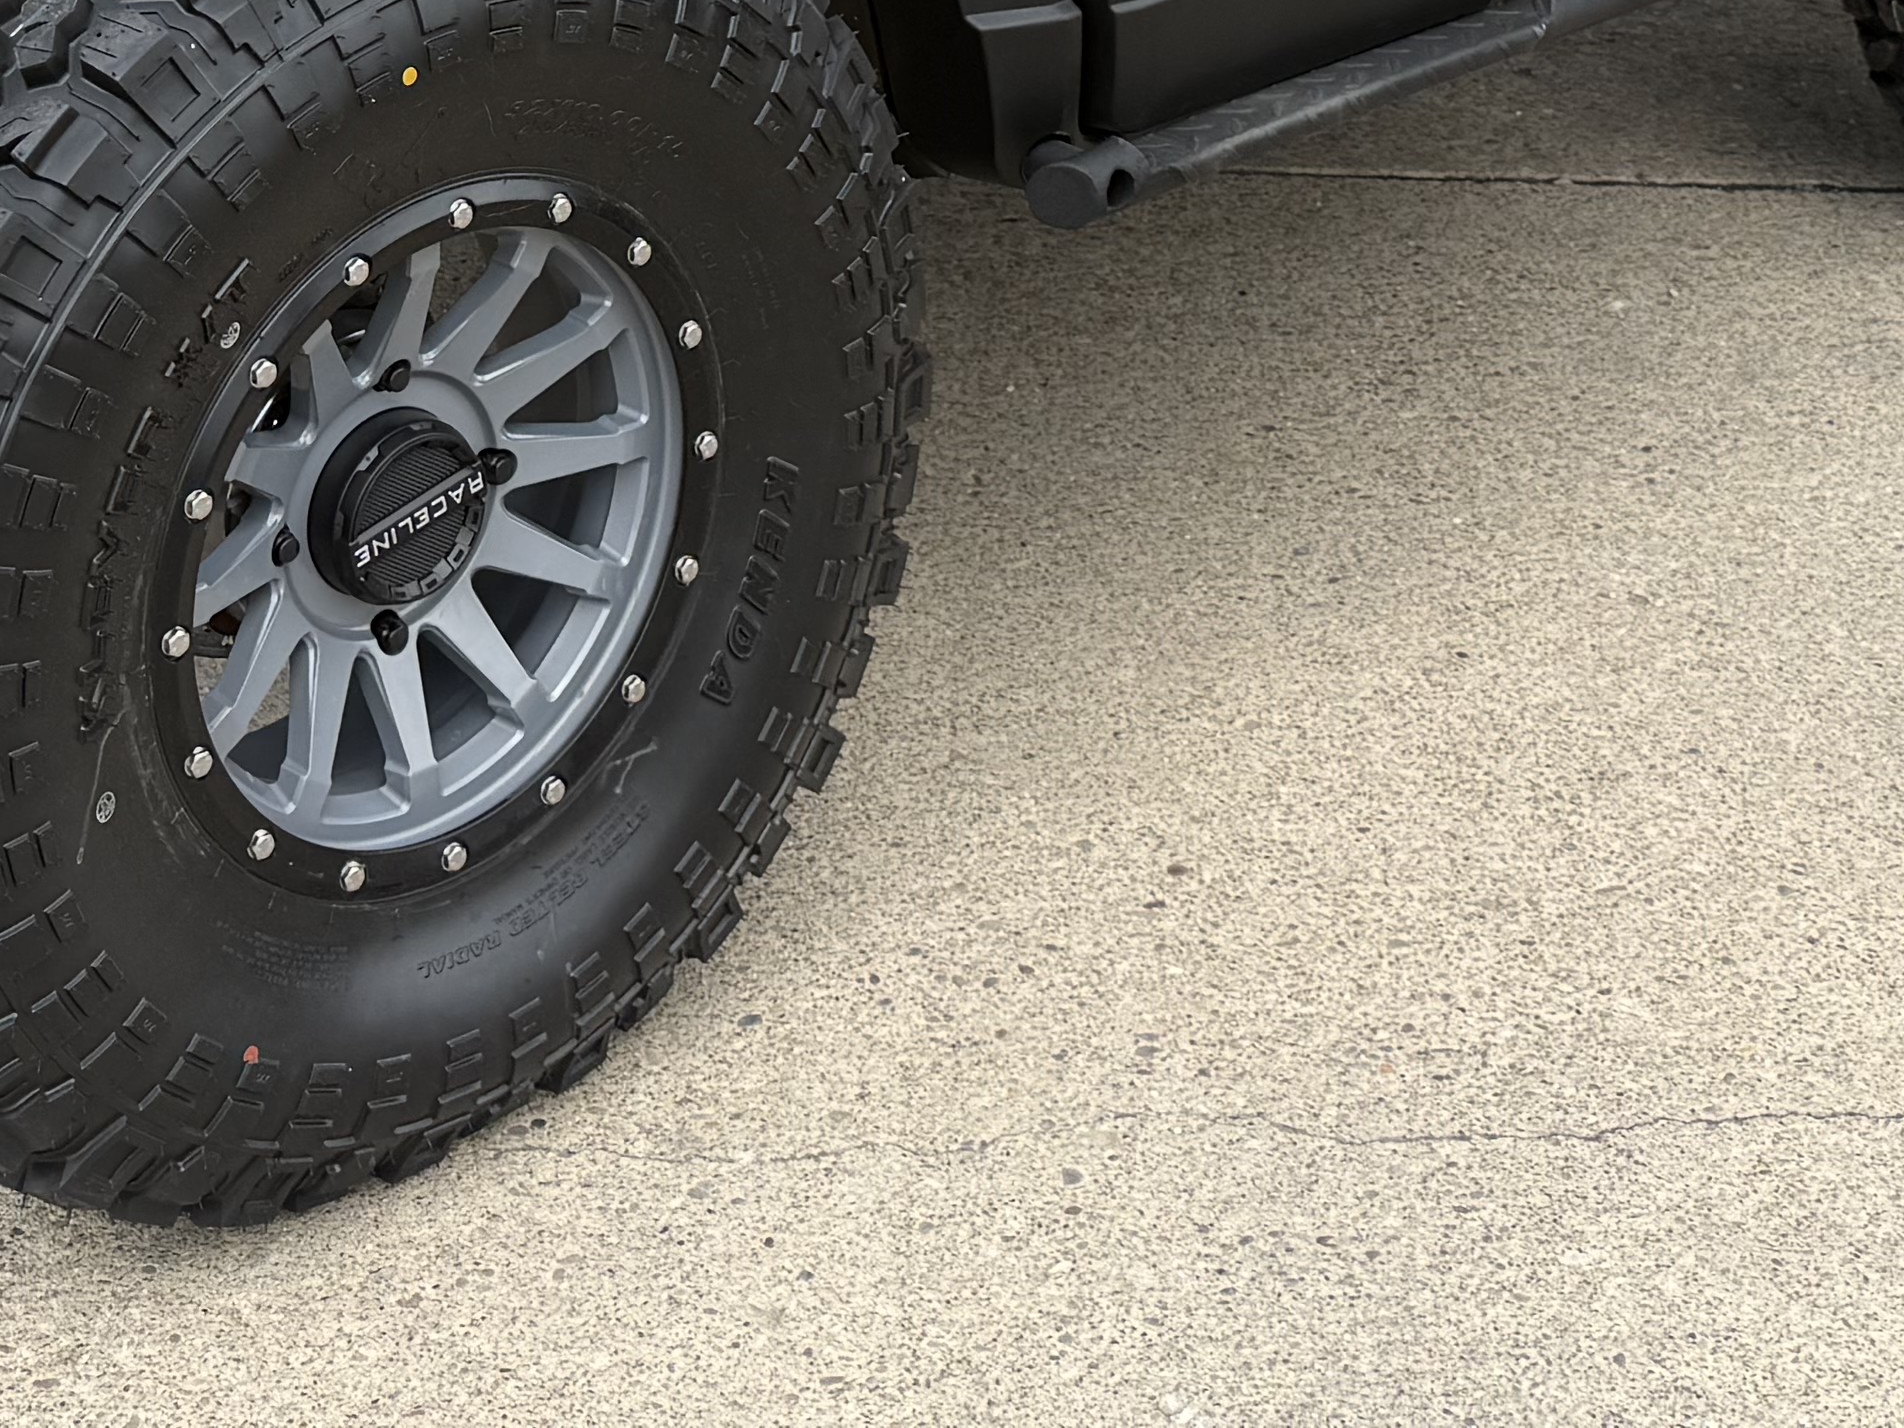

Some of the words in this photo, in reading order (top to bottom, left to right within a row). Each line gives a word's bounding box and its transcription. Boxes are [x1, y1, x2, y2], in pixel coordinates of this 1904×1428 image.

[353, 471, 486, 568] RACELINE
[698, 455, 802, 706] KENDA
[415, 930, 501, 978] RADIAL
